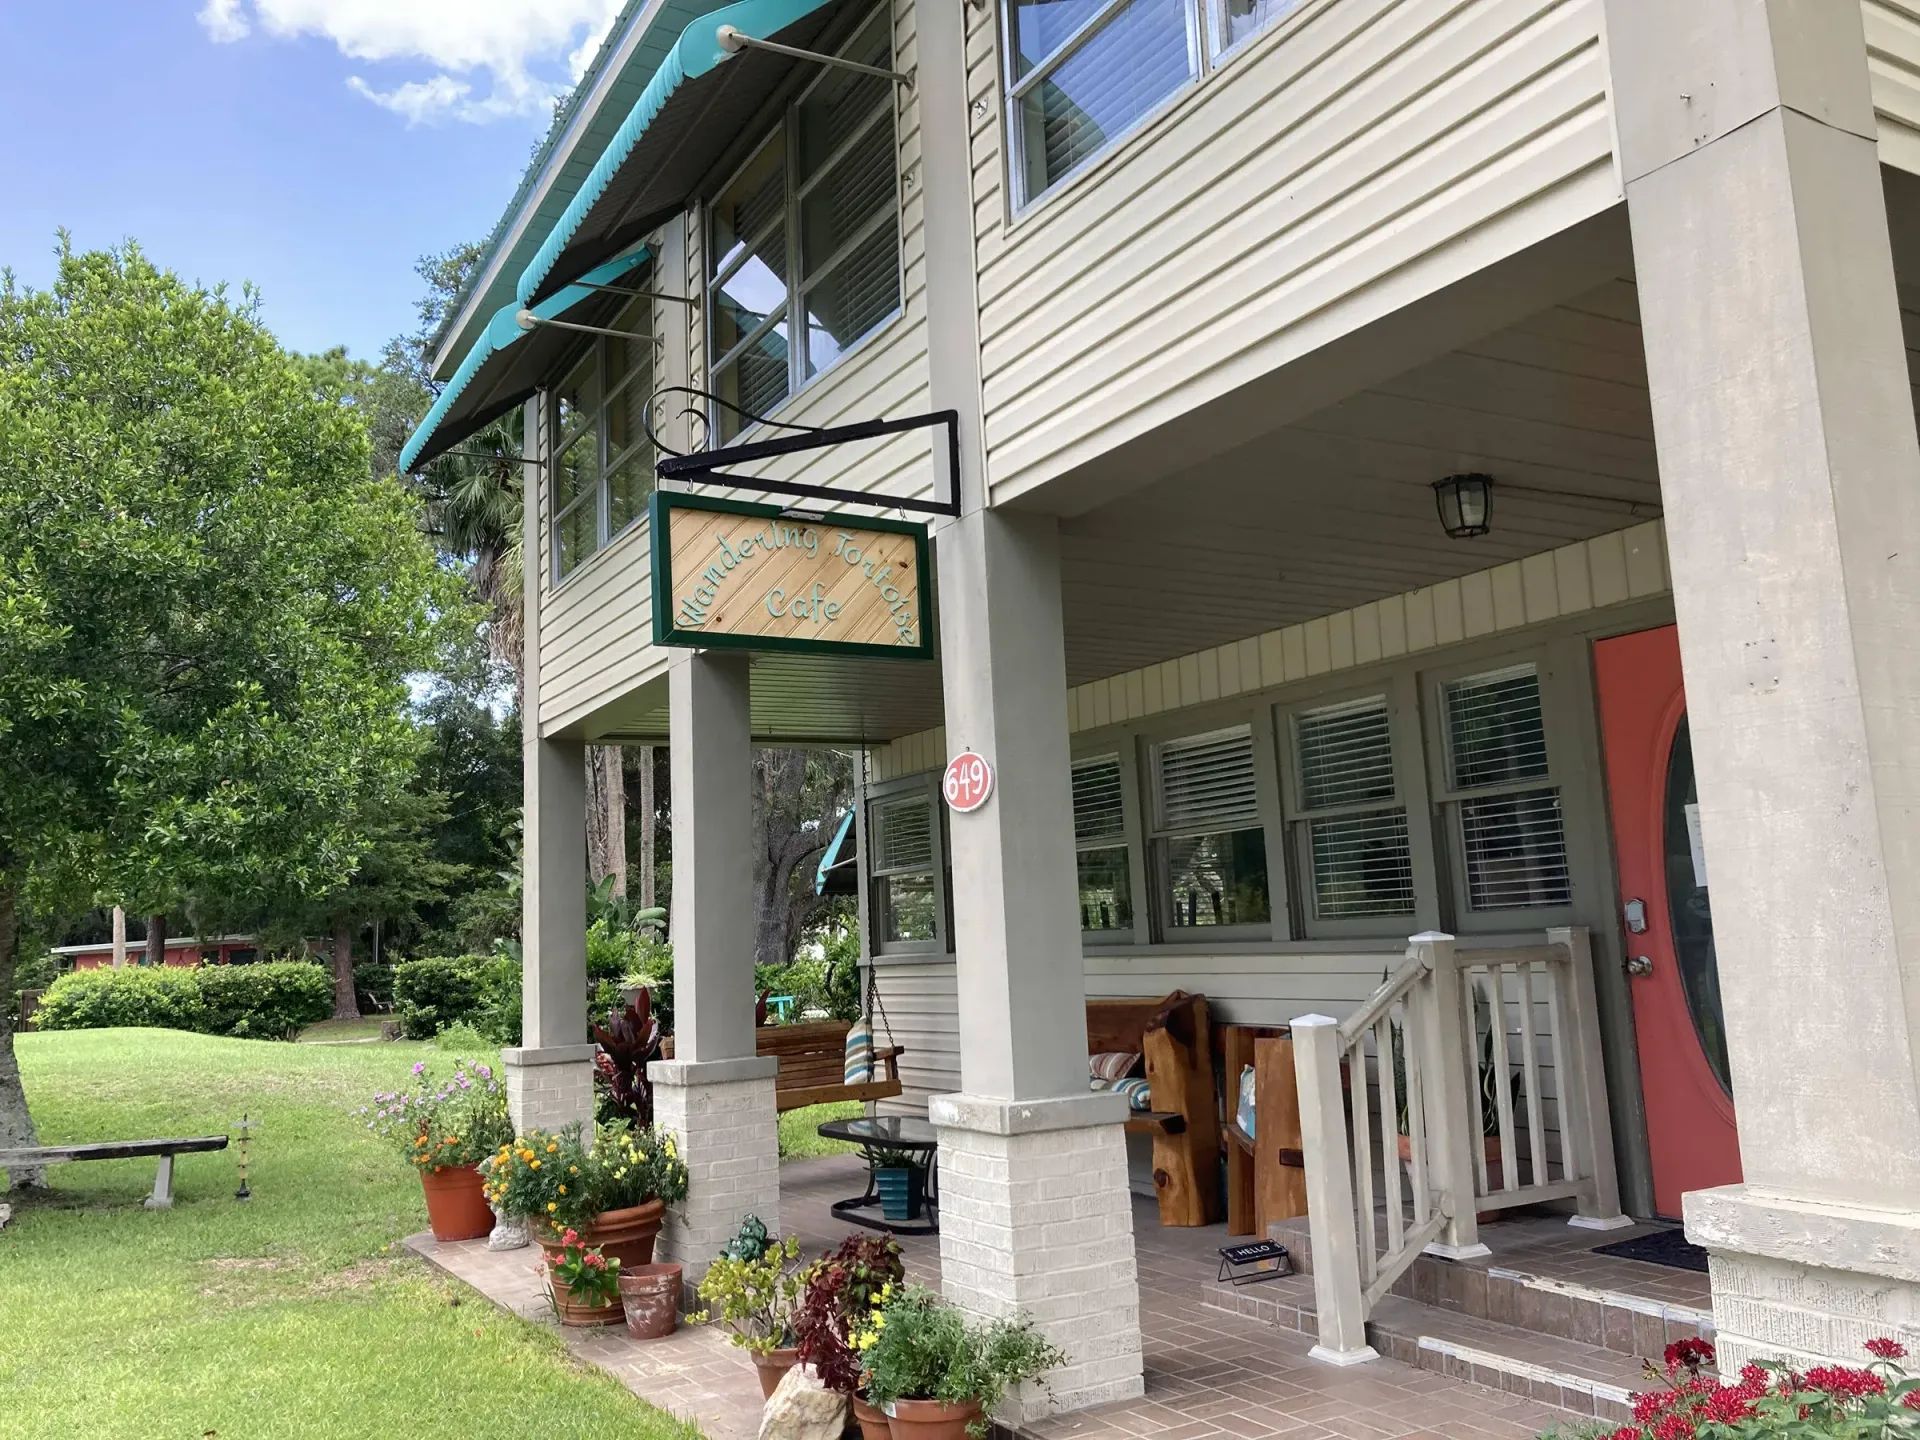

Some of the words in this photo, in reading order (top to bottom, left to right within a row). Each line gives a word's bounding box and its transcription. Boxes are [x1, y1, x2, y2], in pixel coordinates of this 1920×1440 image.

[675, 520, 819, 627] Wandering
[833, 532, 915, 645] Tortoise
[766, 582, 841, 623] Cafe
[946, 759, 984, 801] 649
[1237, 1244, 1270, 1256] HELLO
